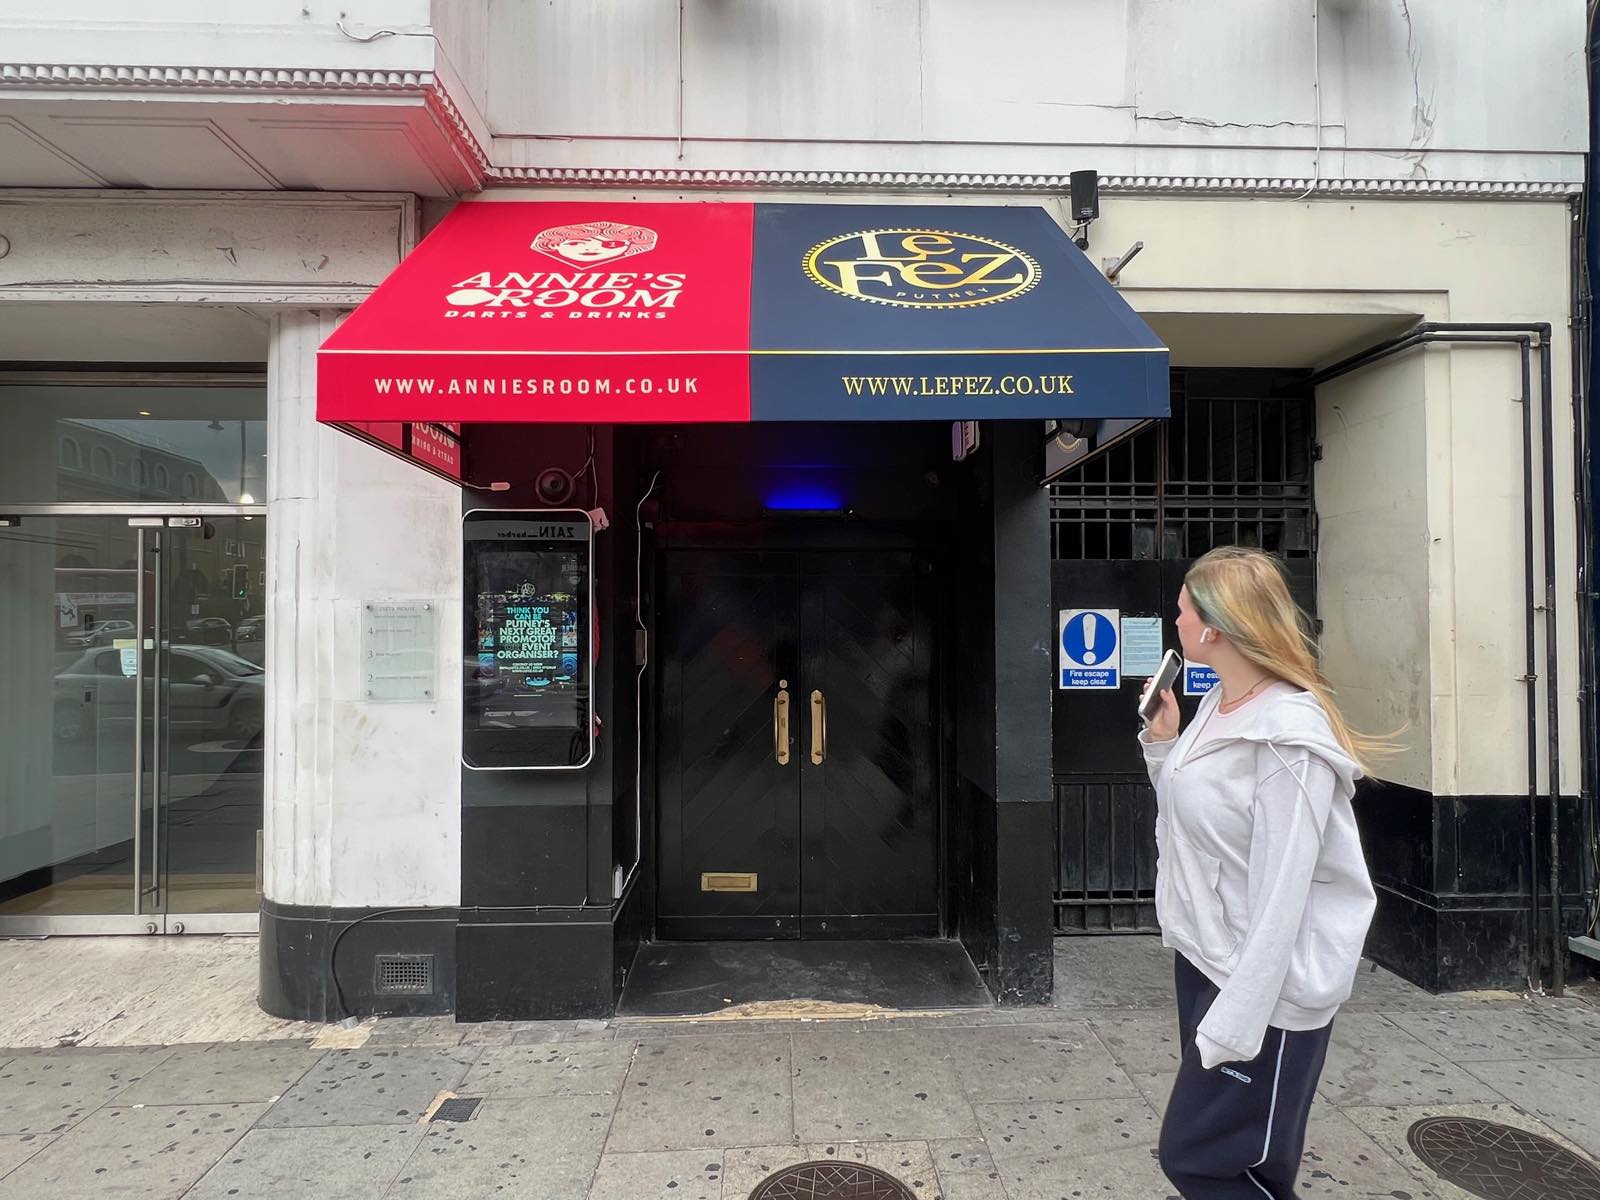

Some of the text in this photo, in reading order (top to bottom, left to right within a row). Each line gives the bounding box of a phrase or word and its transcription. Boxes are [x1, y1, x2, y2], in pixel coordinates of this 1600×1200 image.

[856, 232, 955, 260] Le
[451, 271, 687, 290] ANNIE'S
[896, 287, 988, 300] PUTNEY
[484, 289, 683, 308] ROOM
[444, 311, 666, 319] DARTS & DRINKS
[374, 377, 698, 395] WWW.ANNIESROOM.CO.UK
[842, 375, 1074, 396] WWW.LEFEZ.CO.UK
[506, 620, 550, 628] PUTNEY'S
[500, 627, 557, 636] NEXT GREAT
[500, 635, 556, 644] PROMOTOR
[522, 643, 551, 651] EVENT
[497, 651, 559, 659] ORGANISER?
[1070, 670, 1083, 678] Fire
[1191, 671, 1205, 679] Fire
[1072, 678, 1089, 686] keep
[1193, 681, 1211, 690] keep
